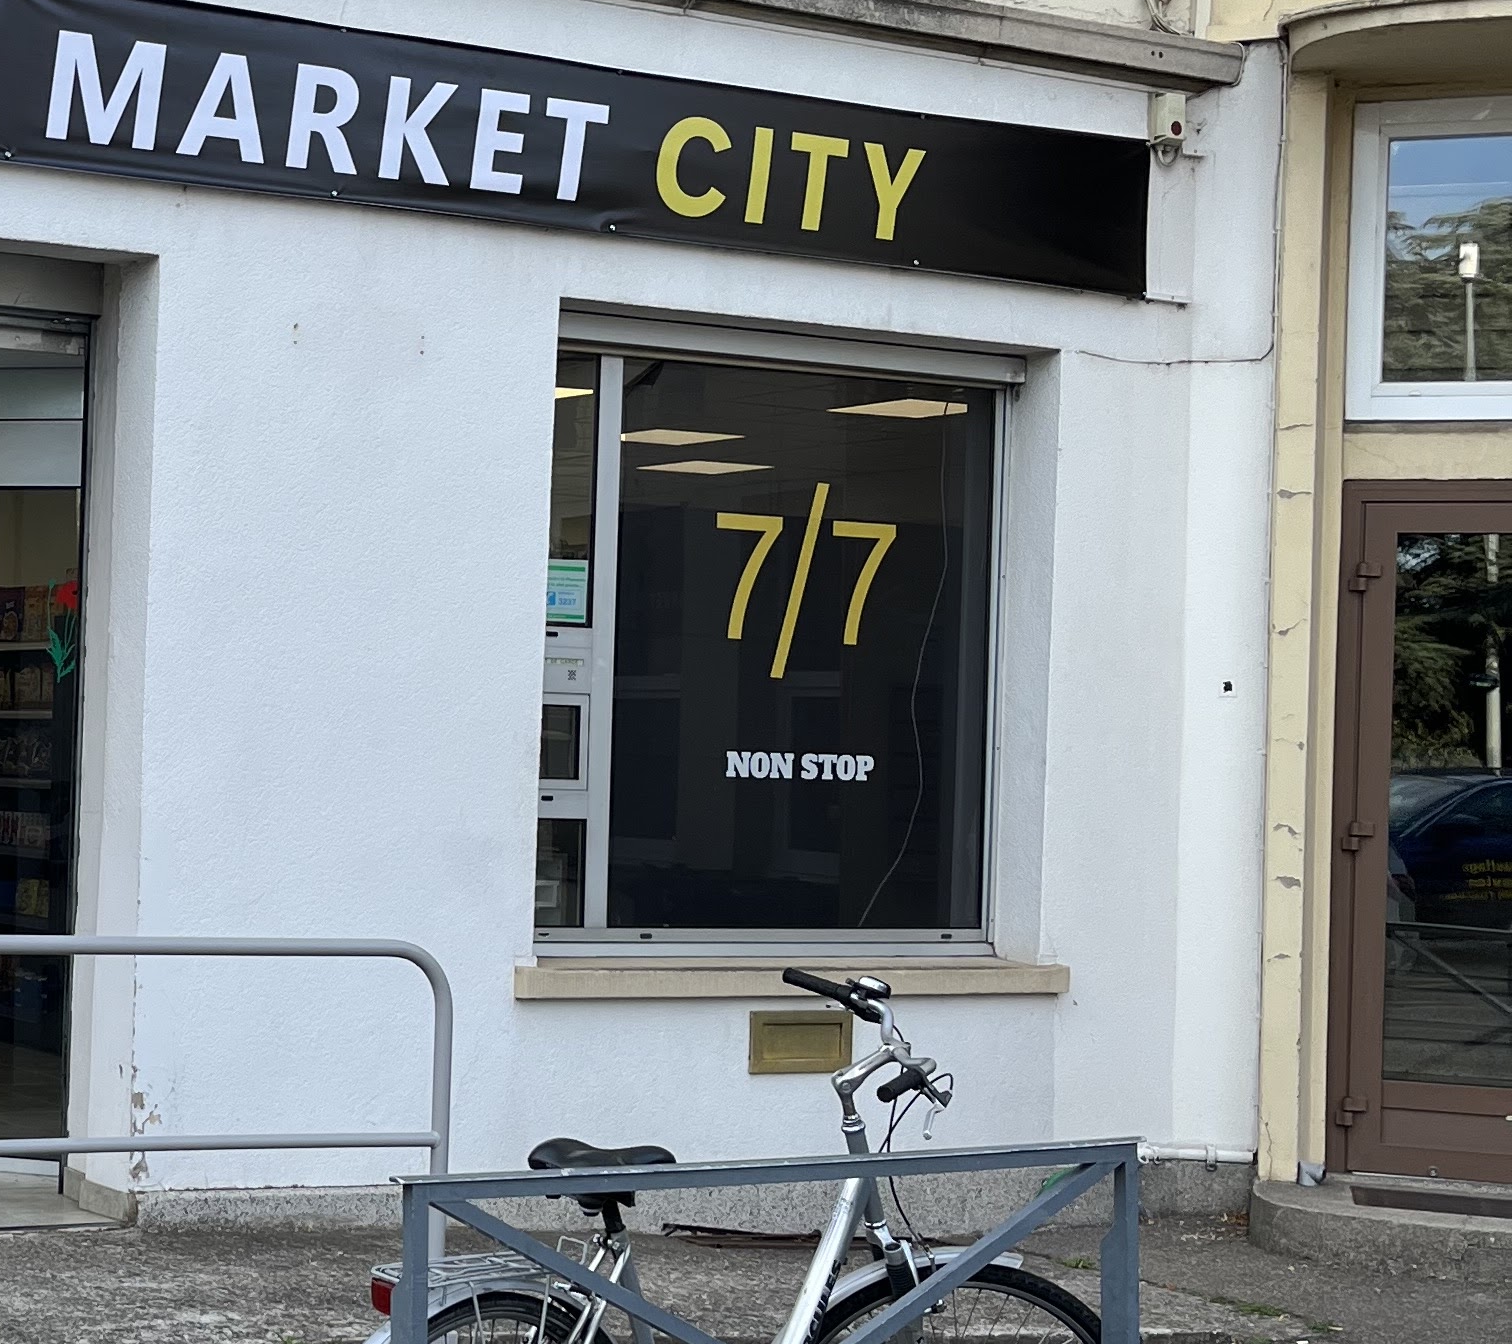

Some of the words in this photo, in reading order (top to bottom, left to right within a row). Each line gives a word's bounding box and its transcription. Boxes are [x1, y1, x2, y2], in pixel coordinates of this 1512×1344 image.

[46, 29, 610, 202] MARKET
[656, 117, 926, 241] CITY
[716, 483, 897, 679] 7/7
[725, 750, 795, 779] NON
[800, 753, 875, 781] STOP
